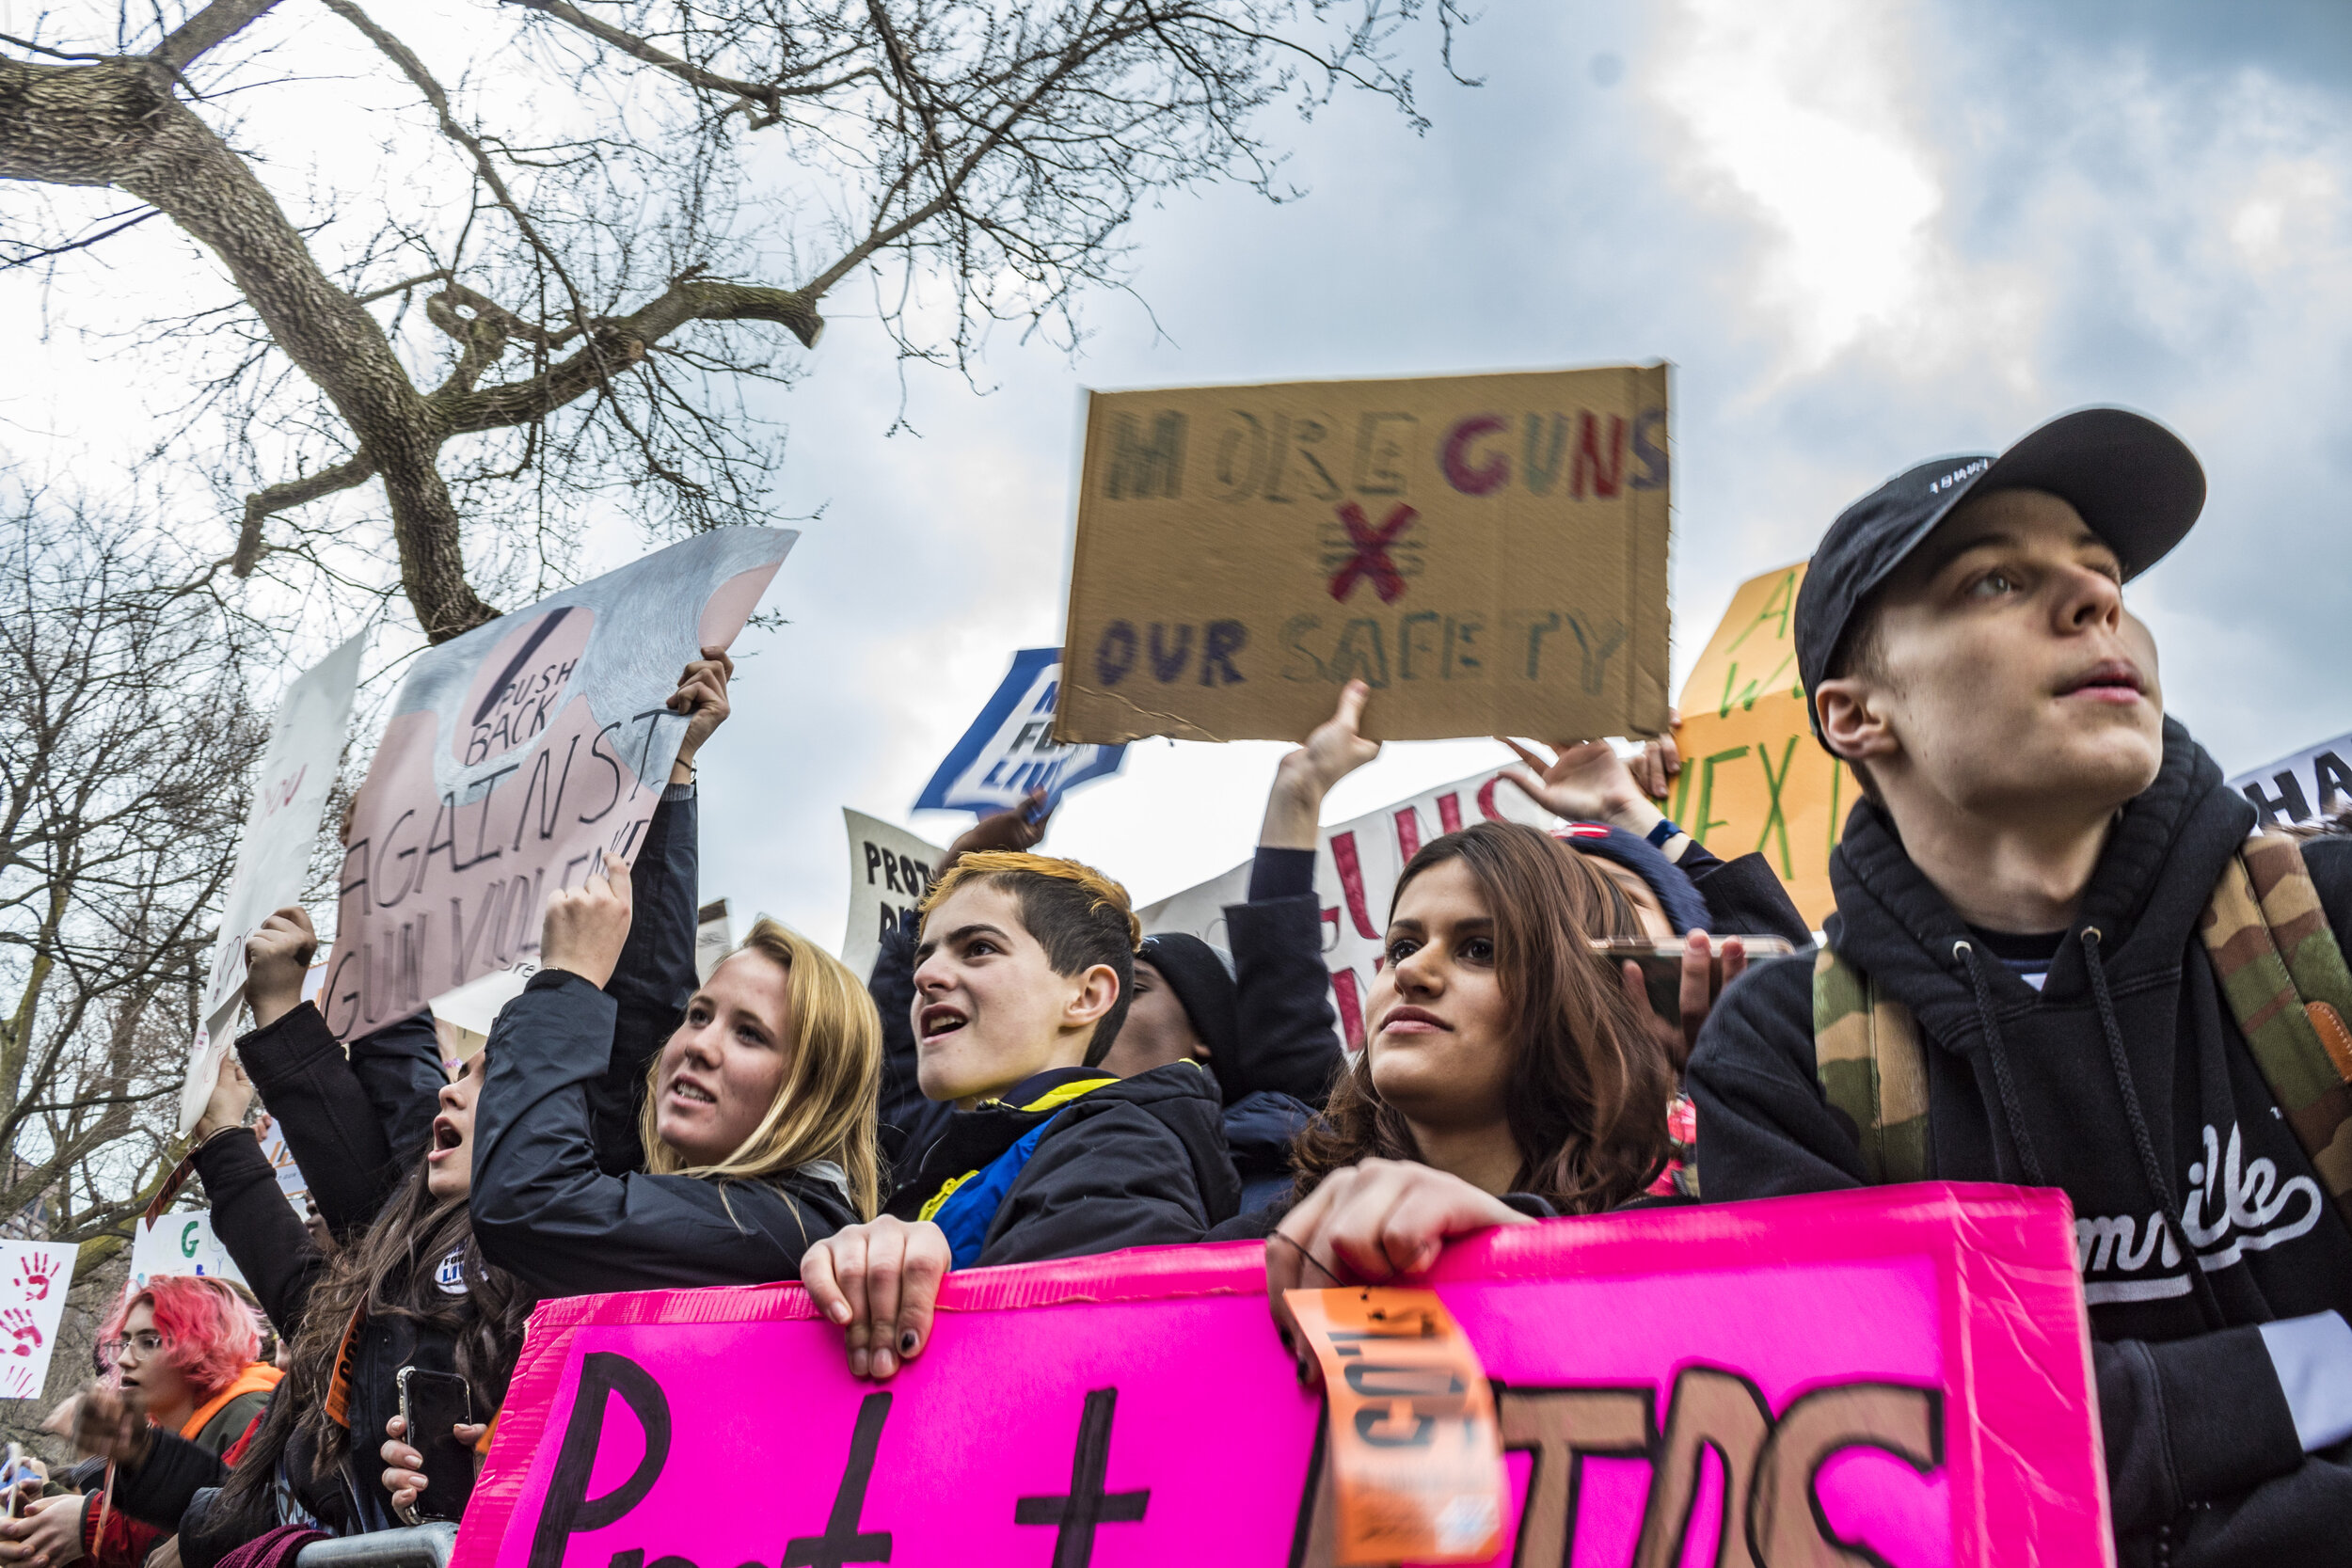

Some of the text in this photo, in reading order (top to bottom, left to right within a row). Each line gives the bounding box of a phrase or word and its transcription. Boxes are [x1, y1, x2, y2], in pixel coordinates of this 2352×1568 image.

[1101, 407, 1668, 503] MORE GUNS
[495, 657, 579, 716] PUSH
[1095, 610, 1628, 694] OUR SAFETY
[465, 690, 559, 767] BACK
[337, 707, 697, 937] AGAINST
[323, 912, 428, 1042] GUN
